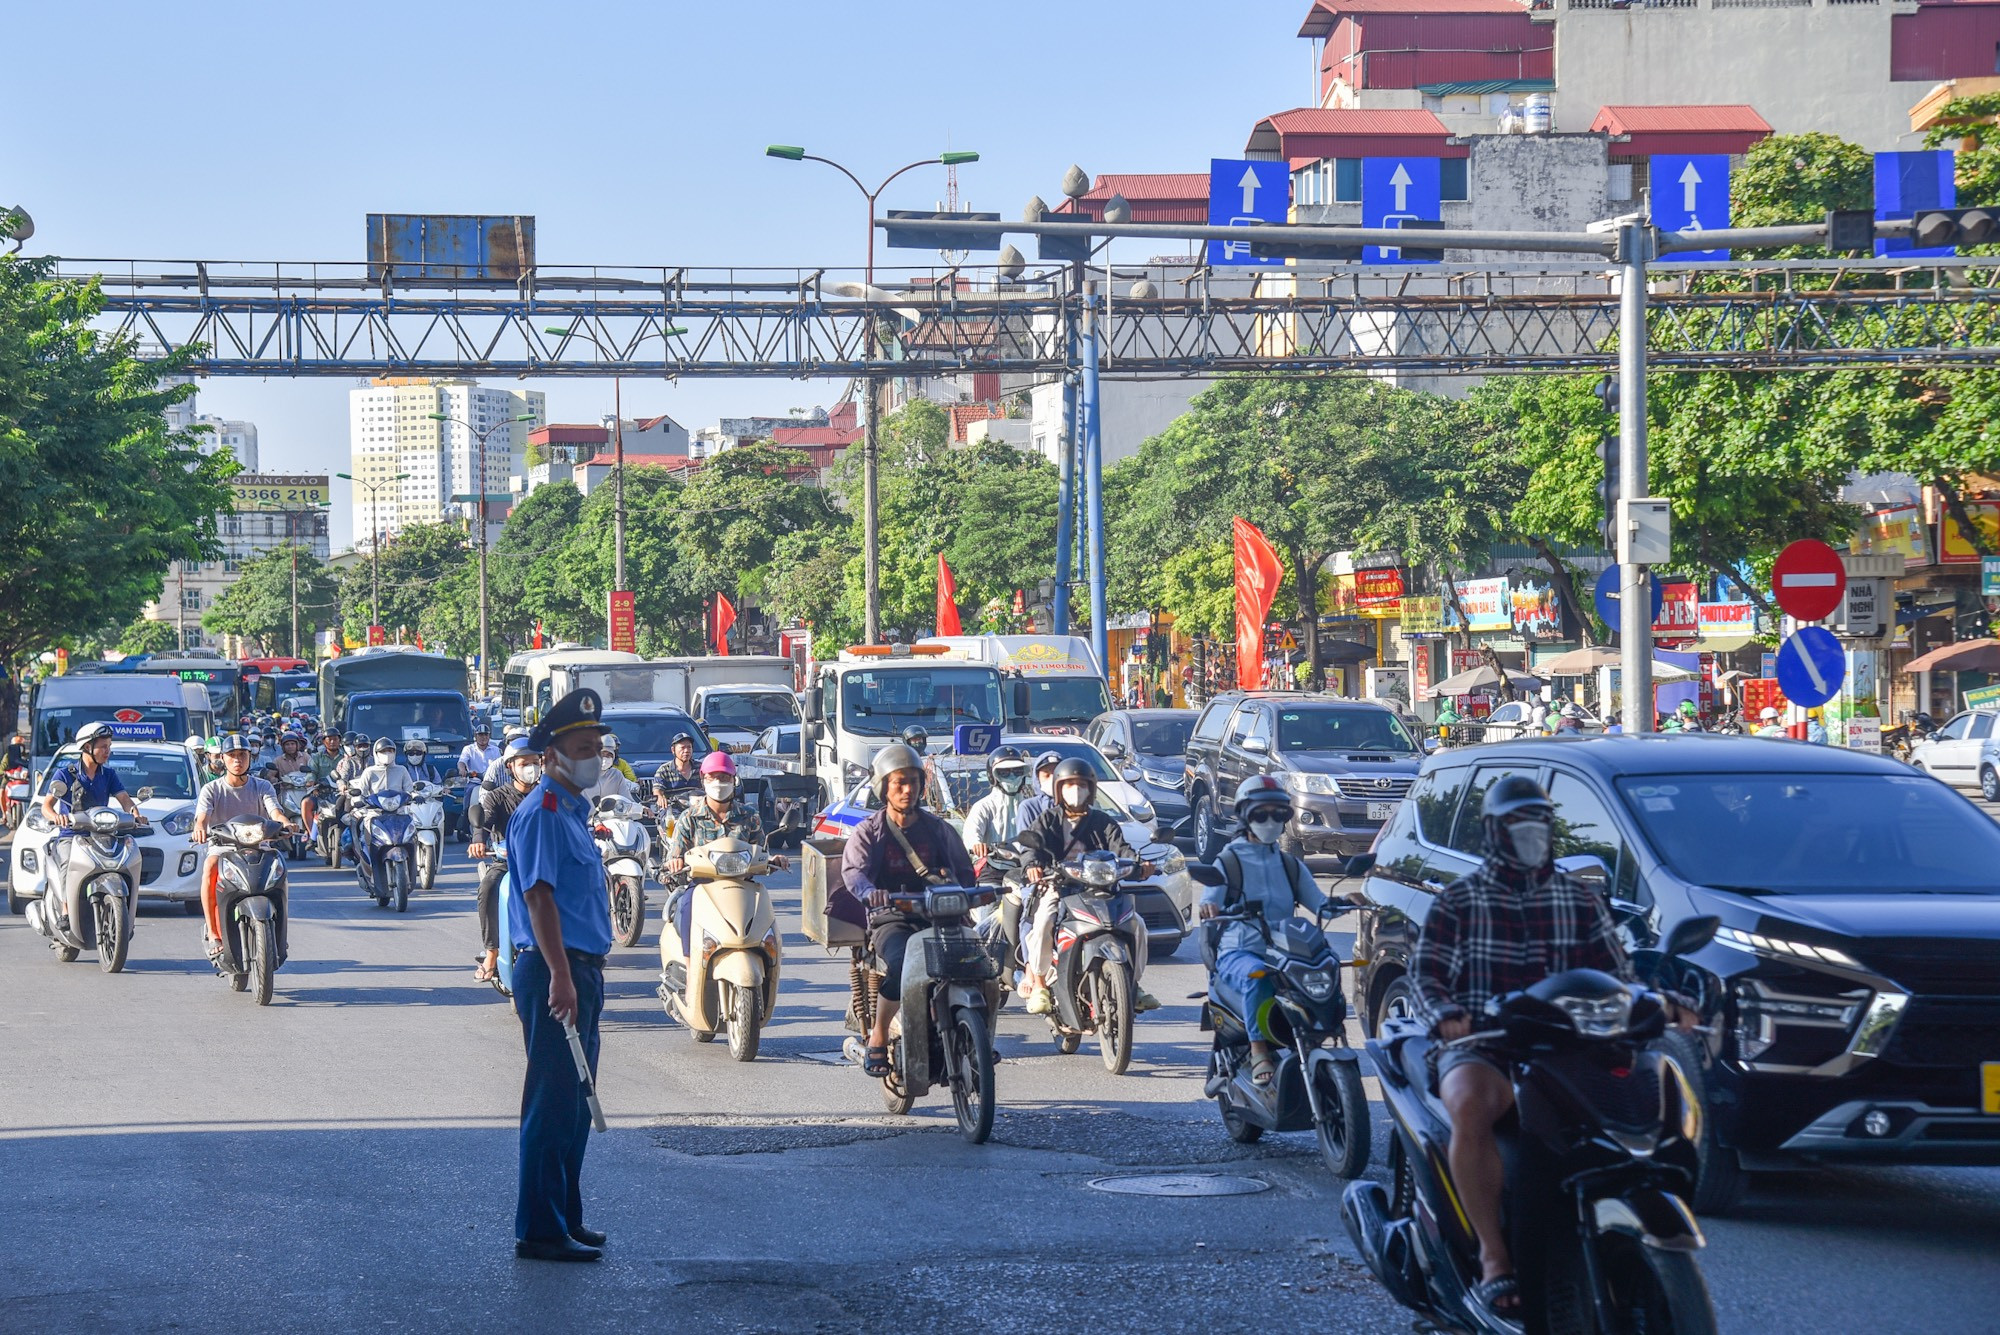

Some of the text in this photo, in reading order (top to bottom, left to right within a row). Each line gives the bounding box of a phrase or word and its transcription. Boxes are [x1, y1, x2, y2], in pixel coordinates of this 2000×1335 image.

[232, 476, 318, 484] QUẢNG CÁO
[288, 489, 319, 500] 218
[1851, 584, 1872, 597] NHÀ
[1674, 601, 1684, 624] XE
[1700, 604, 1751, 622] PHOTOCOPY
[1454, 656, 1463, 666] XE
[116, 726, 156, 735] VẠN XUÂN
[968, 728, 992, 752] G7
